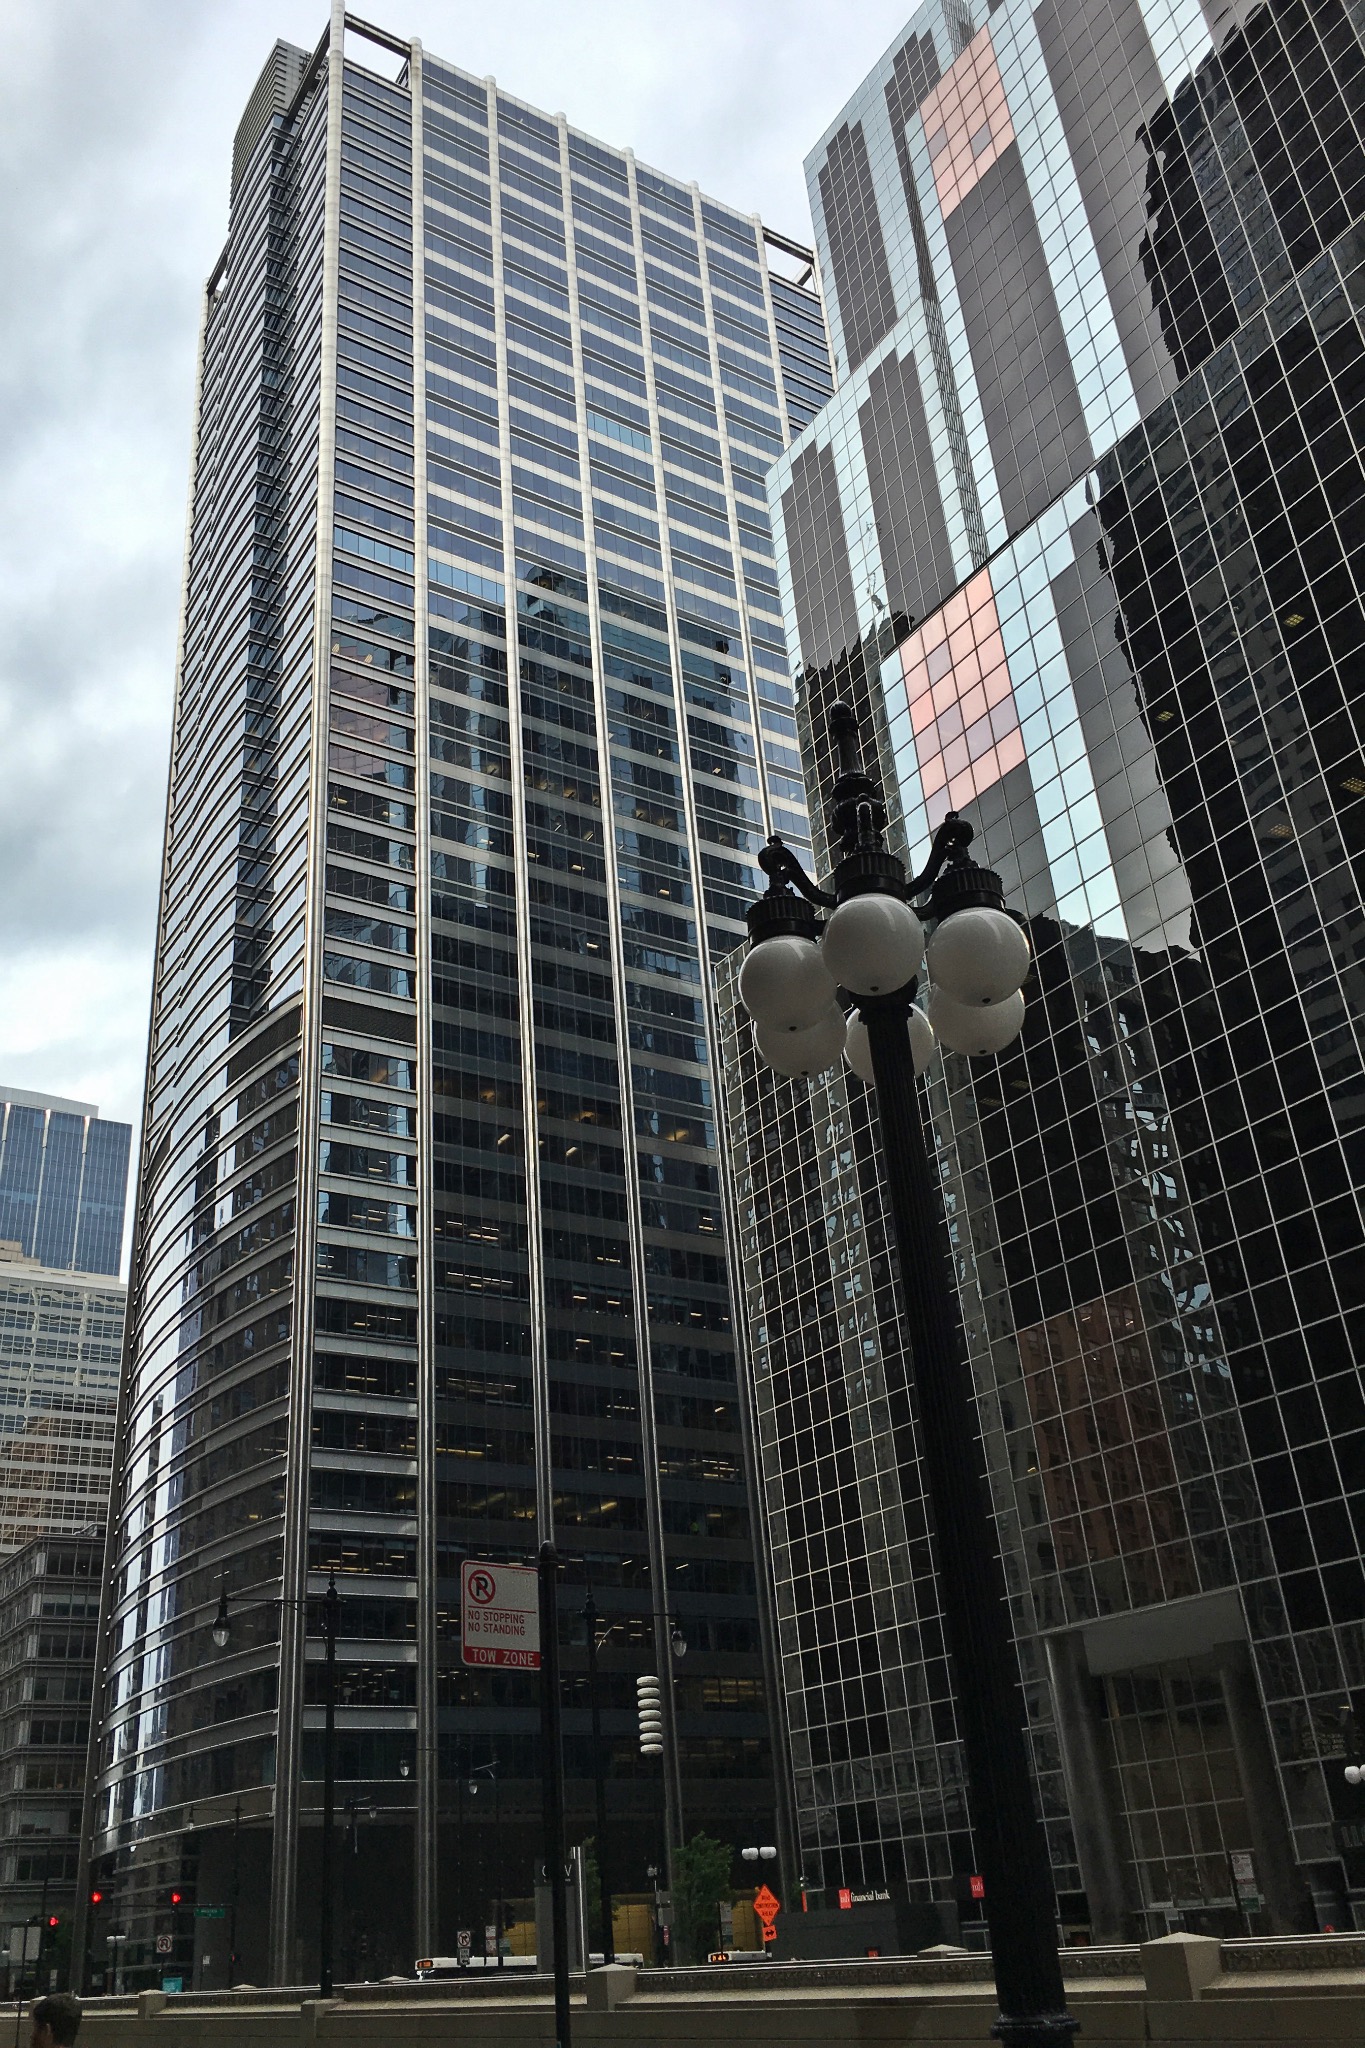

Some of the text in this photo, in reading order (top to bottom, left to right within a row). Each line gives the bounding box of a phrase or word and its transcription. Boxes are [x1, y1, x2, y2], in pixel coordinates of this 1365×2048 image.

[468, 1611, 525, 1624] NO STOPPING
[468, 1622, 526, 1636] NO STANDING
[472, 1649, 535, 1666] TOW ZONE
[850, 1891, 874, 1903] financial
[874, 1889, 890, 1901] bank
